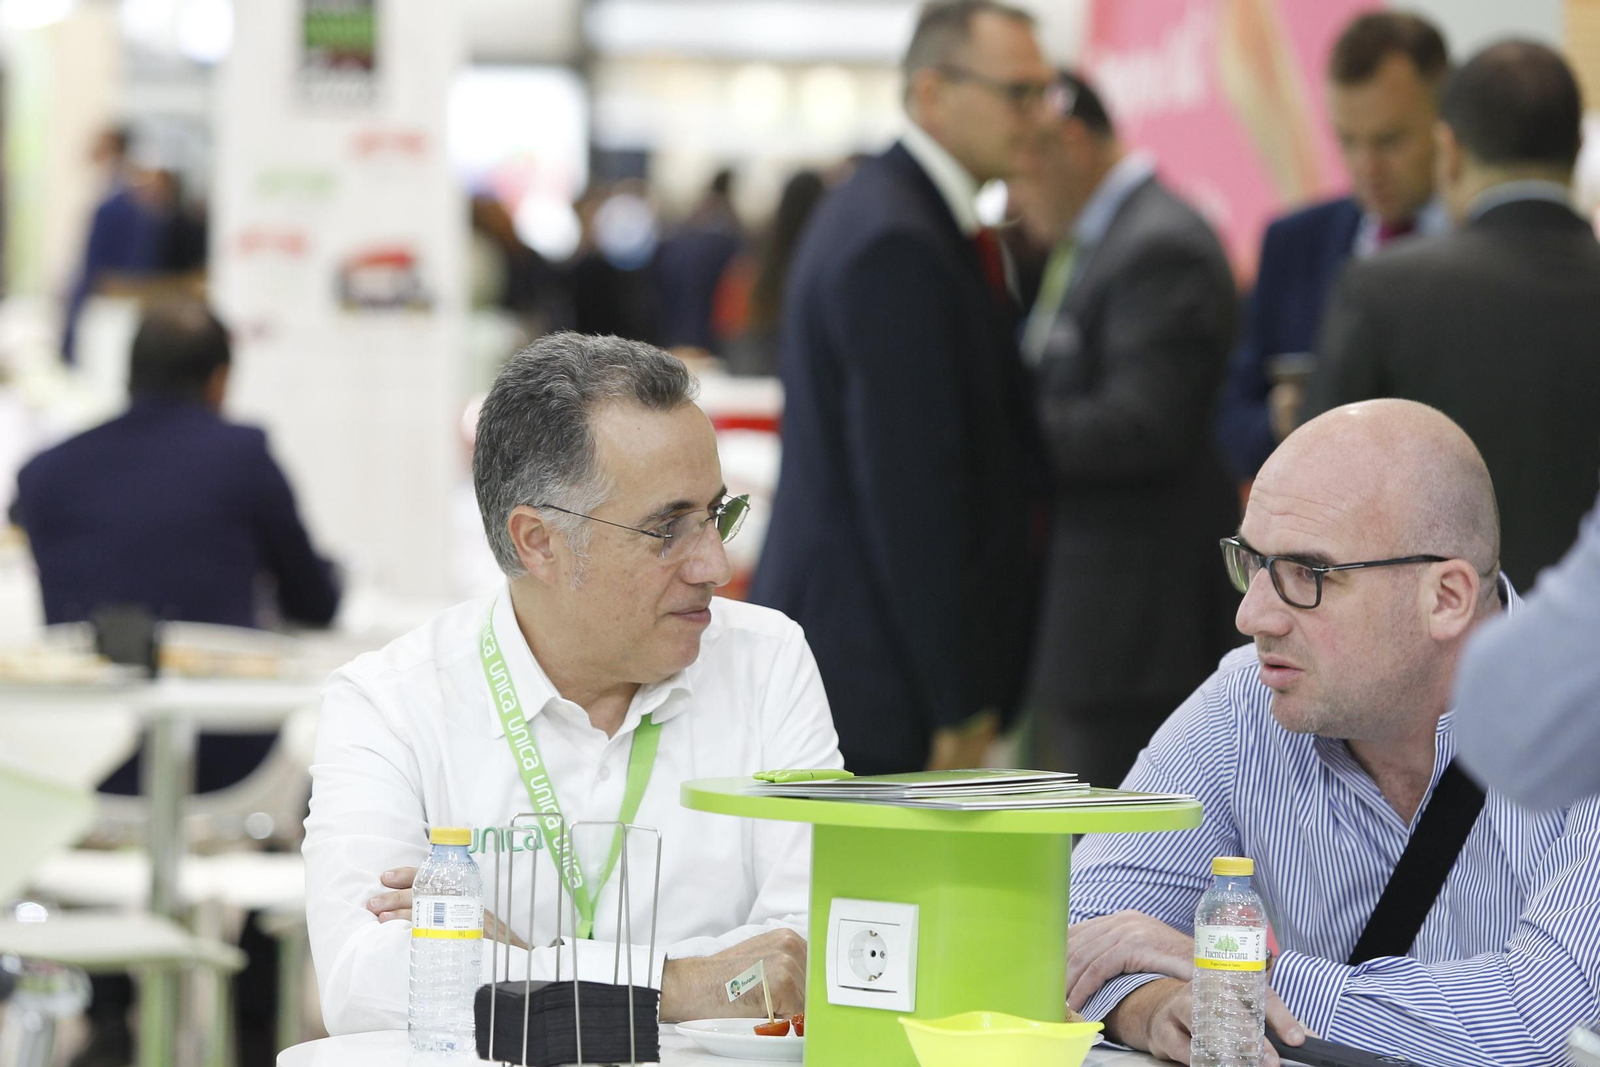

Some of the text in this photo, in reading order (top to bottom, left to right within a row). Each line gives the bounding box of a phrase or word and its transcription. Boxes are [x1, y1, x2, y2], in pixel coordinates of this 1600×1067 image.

[489, 660, 517, 713] unica
[508, 716, 540, 771] unica
[530, 774, 561, 830] unica
